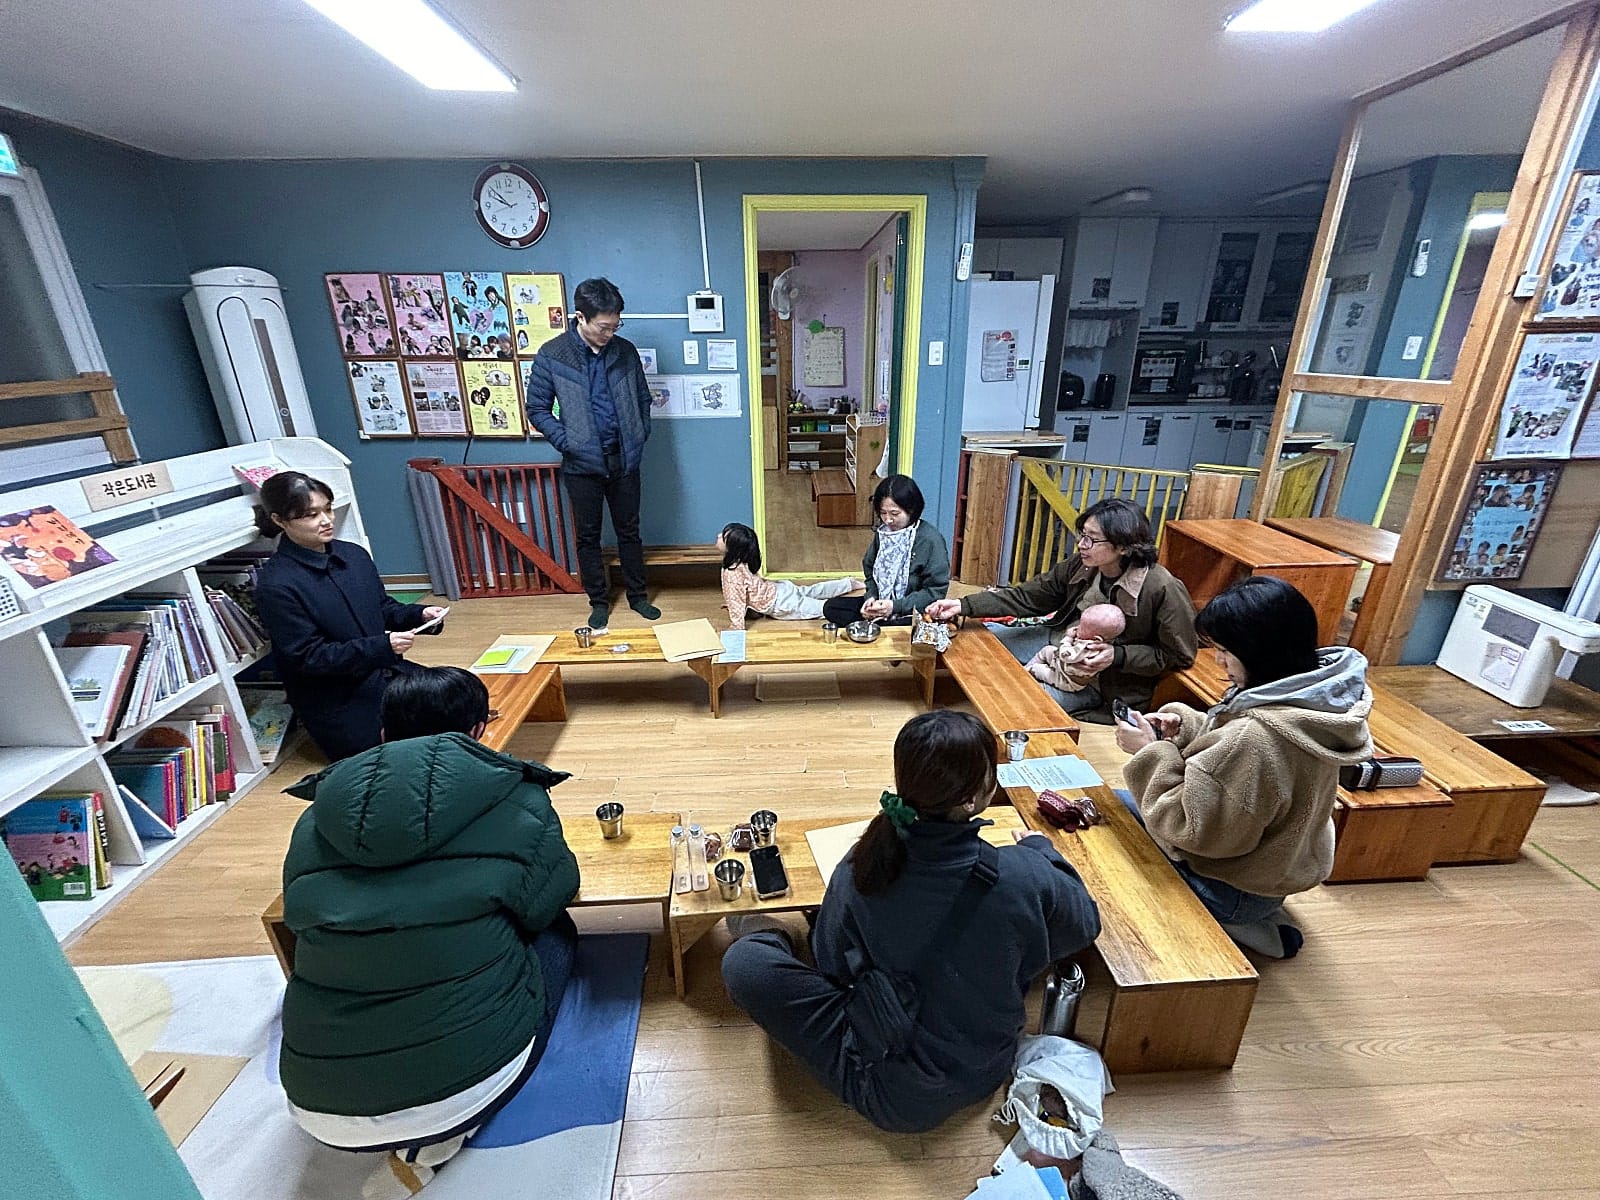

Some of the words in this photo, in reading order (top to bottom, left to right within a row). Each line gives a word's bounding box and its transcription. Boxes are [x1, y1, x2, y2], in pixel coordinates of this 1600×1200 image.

[495, 180, 501, 189] 11
[504, 178, 512, 187] 12
[527, 189, 532, 198] 2
[485, 201, 491, 210] 9
[531, 202, 536, 210] 3
[491, 214, 497, 222] 8
[528, 215, 534, 223] 4
[501, 223, 507, 231] 7
[511, 226, 517, 234] 6
[522, 223, 528, 231] 5
[101, 472, 157, 498] 작은도서관
